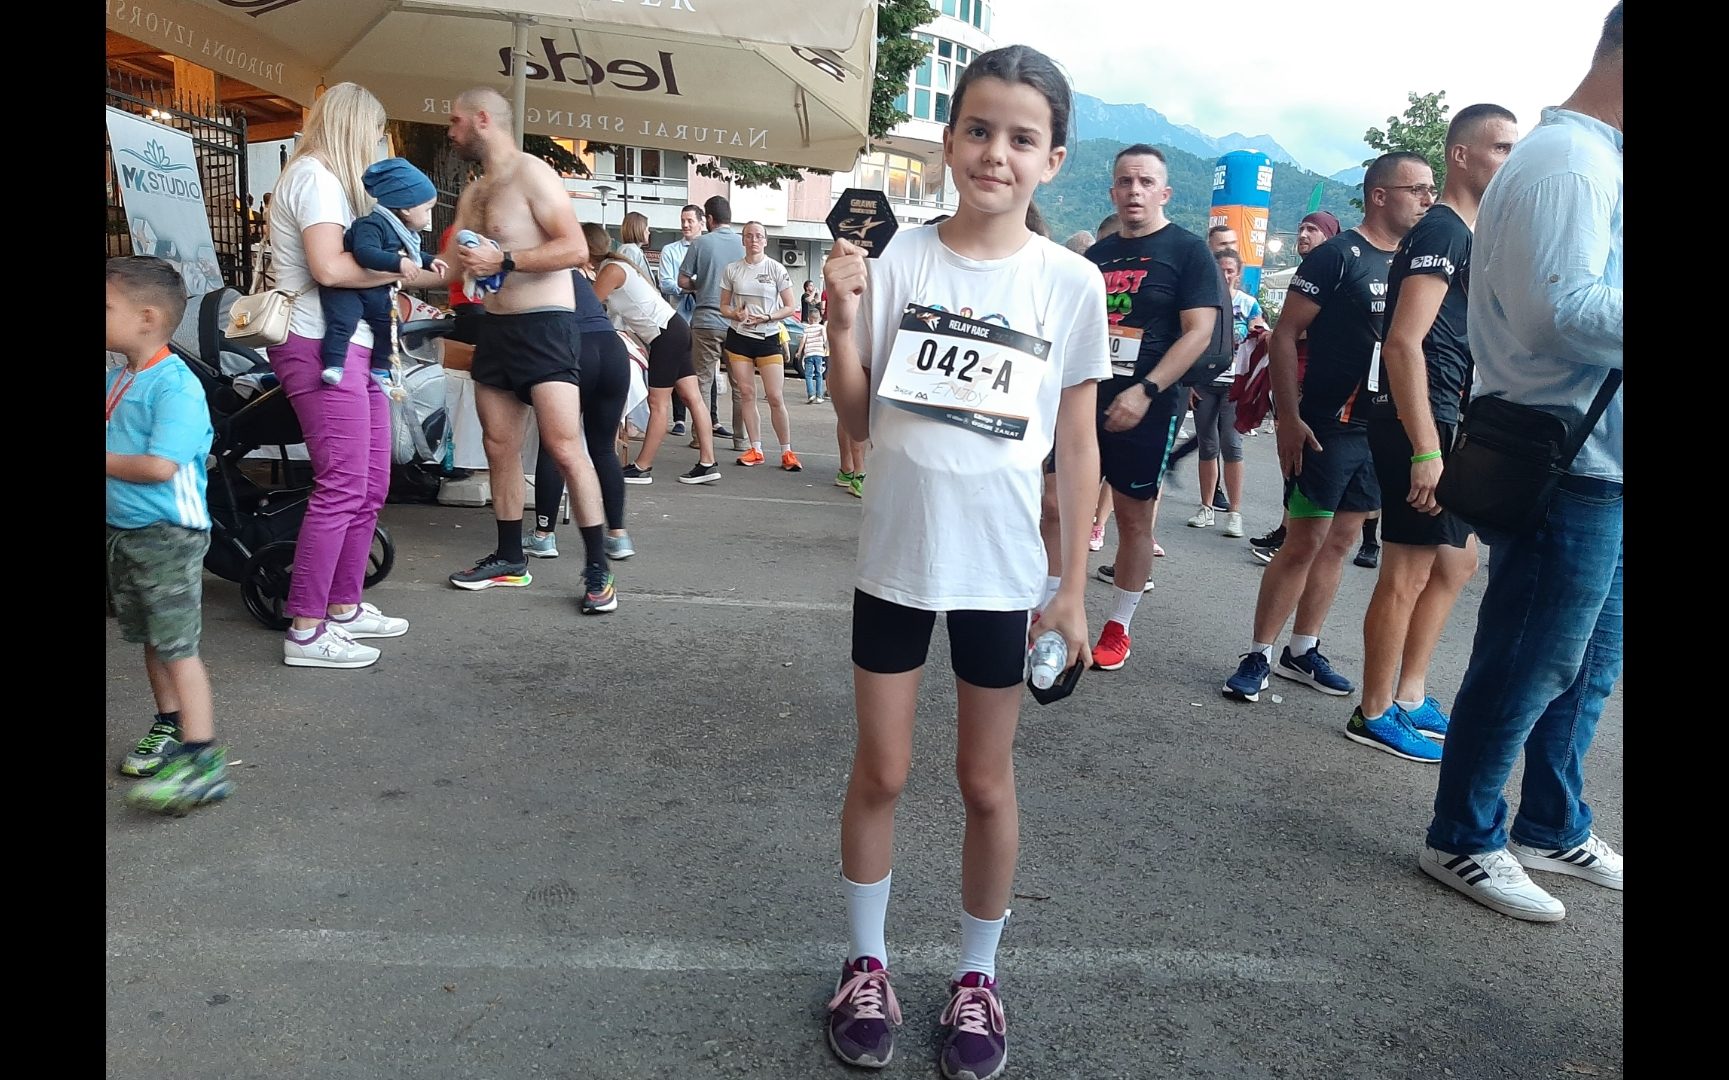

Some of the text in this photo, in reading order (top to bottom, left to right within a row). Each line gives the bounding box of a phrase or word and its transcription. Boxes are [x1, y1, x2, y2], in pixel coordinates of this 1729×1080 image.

[148, 170, 201, 199] STUDIO
[850, 199, 878, 209] GRAWE
[1103, 269, 1148, 294] UST
[949, 319, 972, 334] RELAY
[970, 325, 991, 339] RACE
[916, 339, 1013, 394] 042-A
